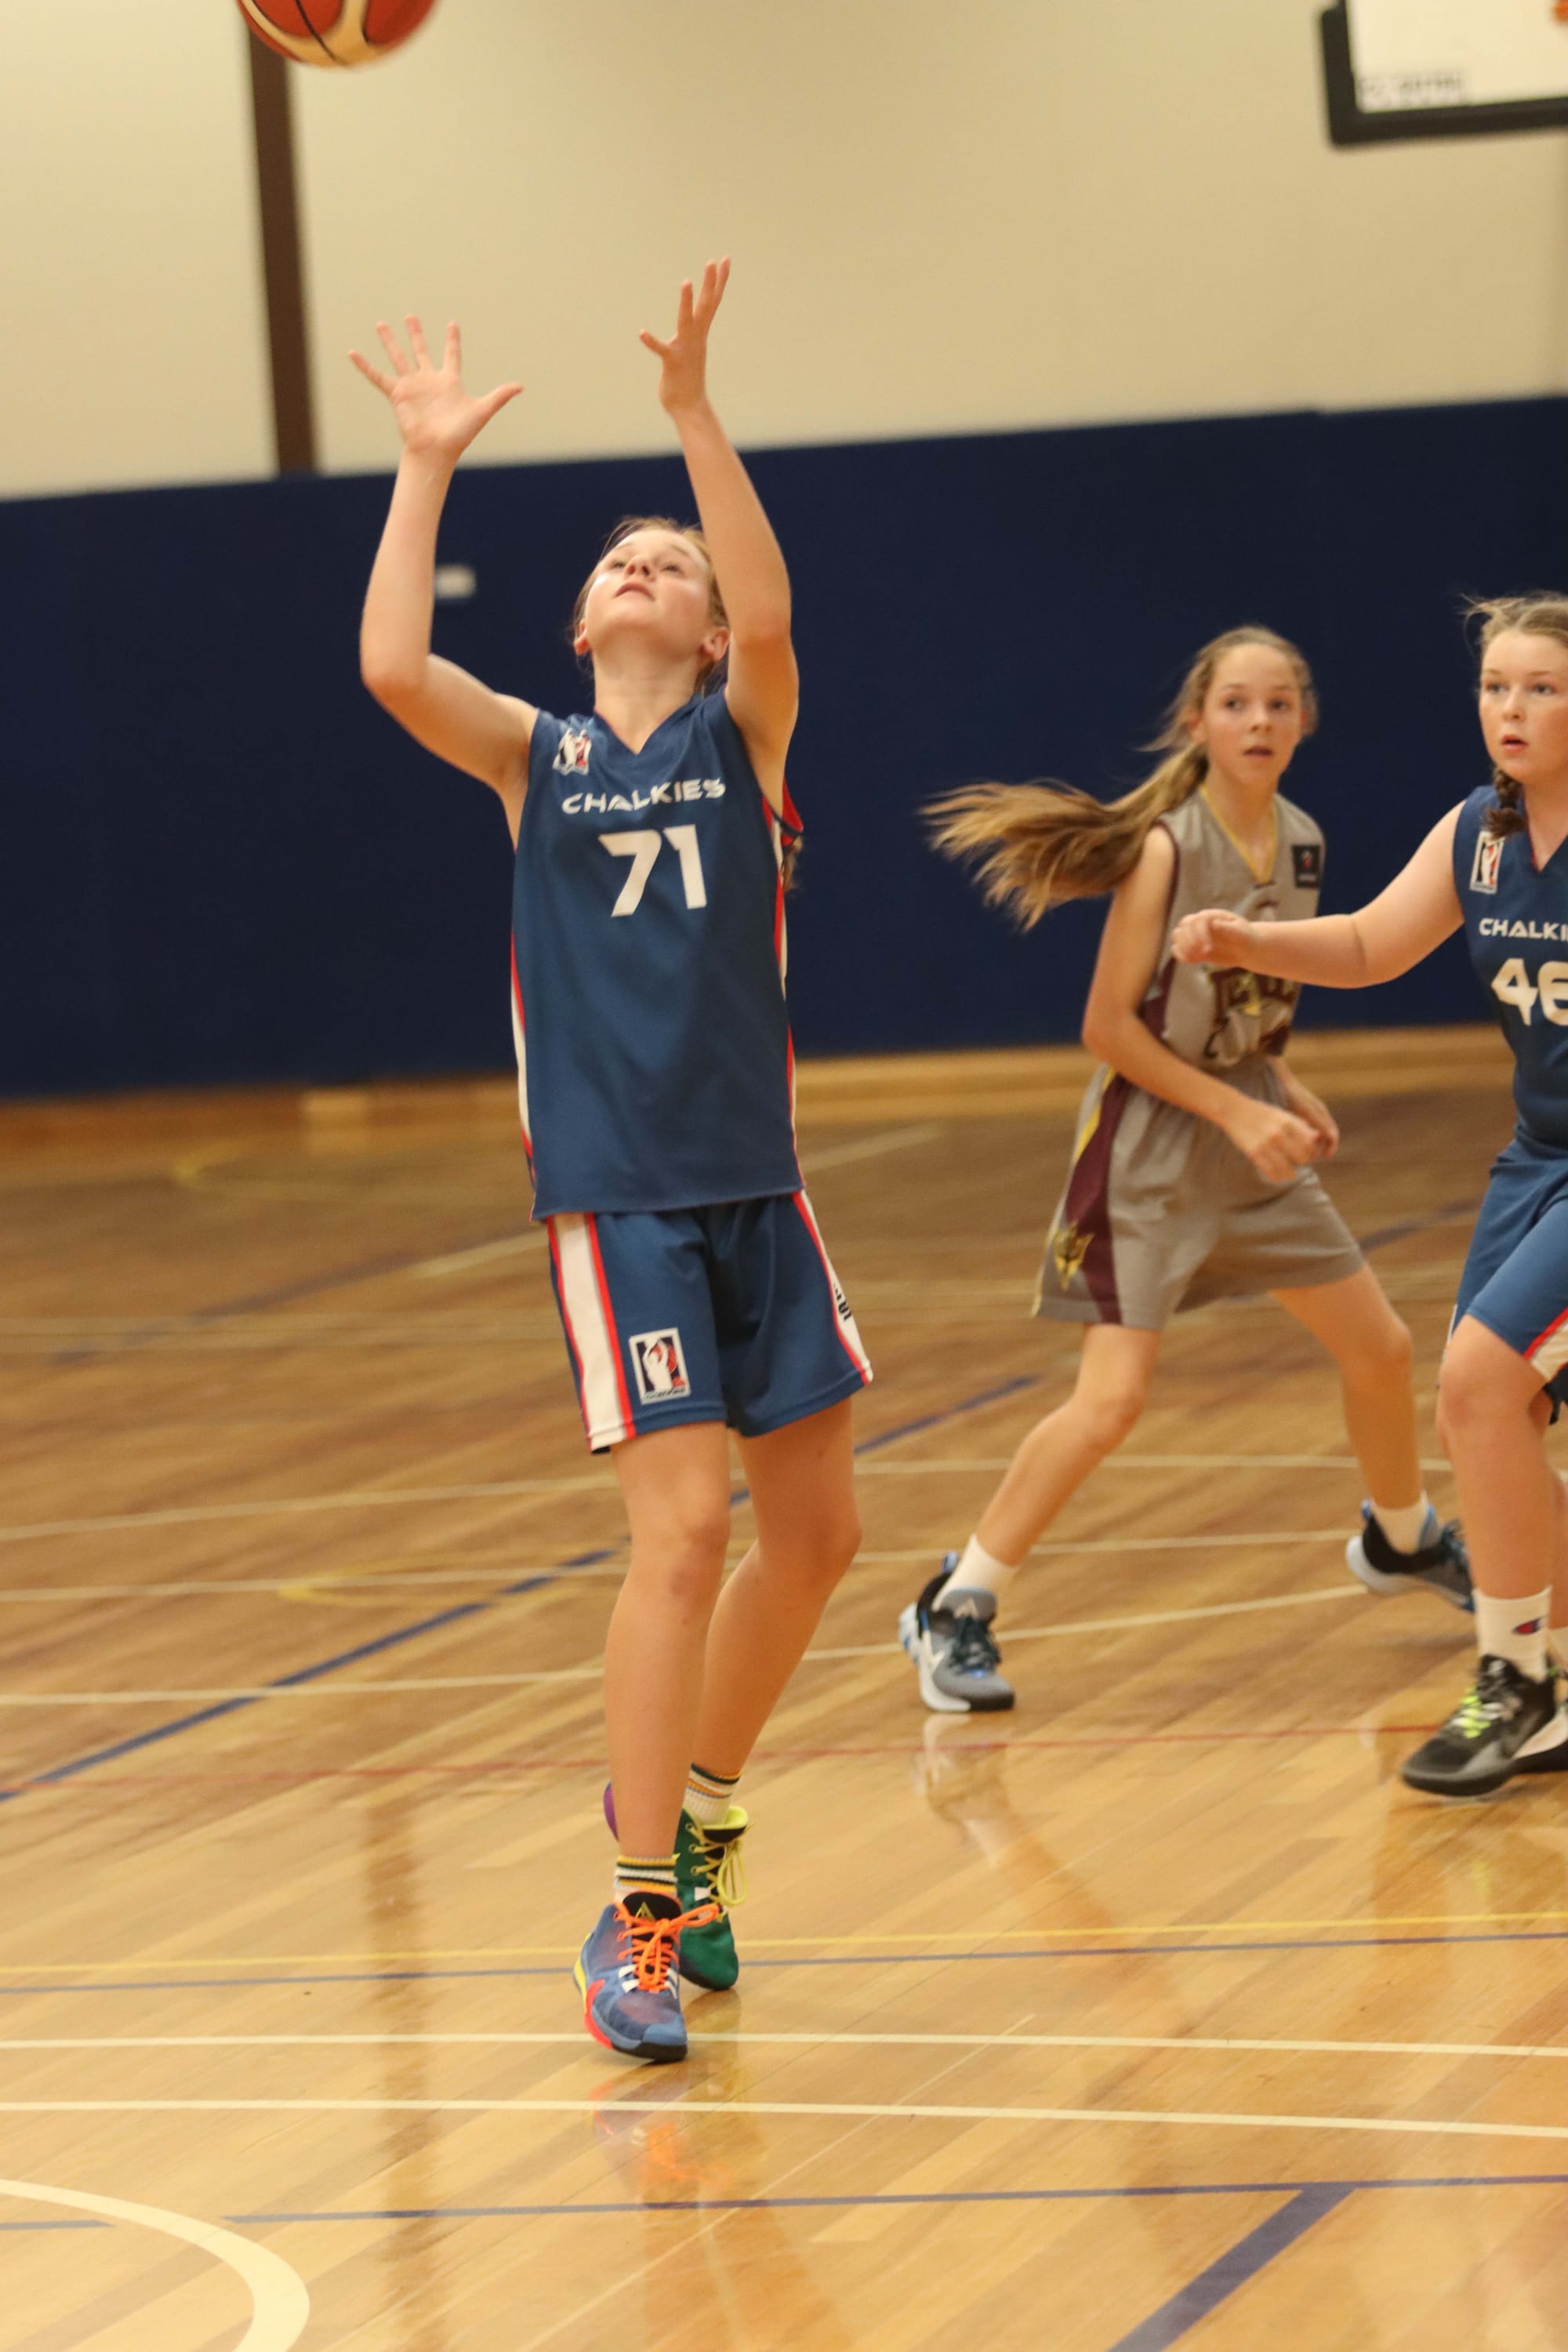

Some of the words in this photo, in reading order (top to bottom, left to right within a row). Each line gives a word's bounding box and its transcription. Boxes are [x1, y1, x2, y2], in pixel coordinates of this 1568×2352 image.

[561, 778, 726, 815] CHALKIES
[597, 824, 707, 917] 71
[1479, 918, 1568, 942] CHALKI
[1491, 957, 1568, 1027] 46
